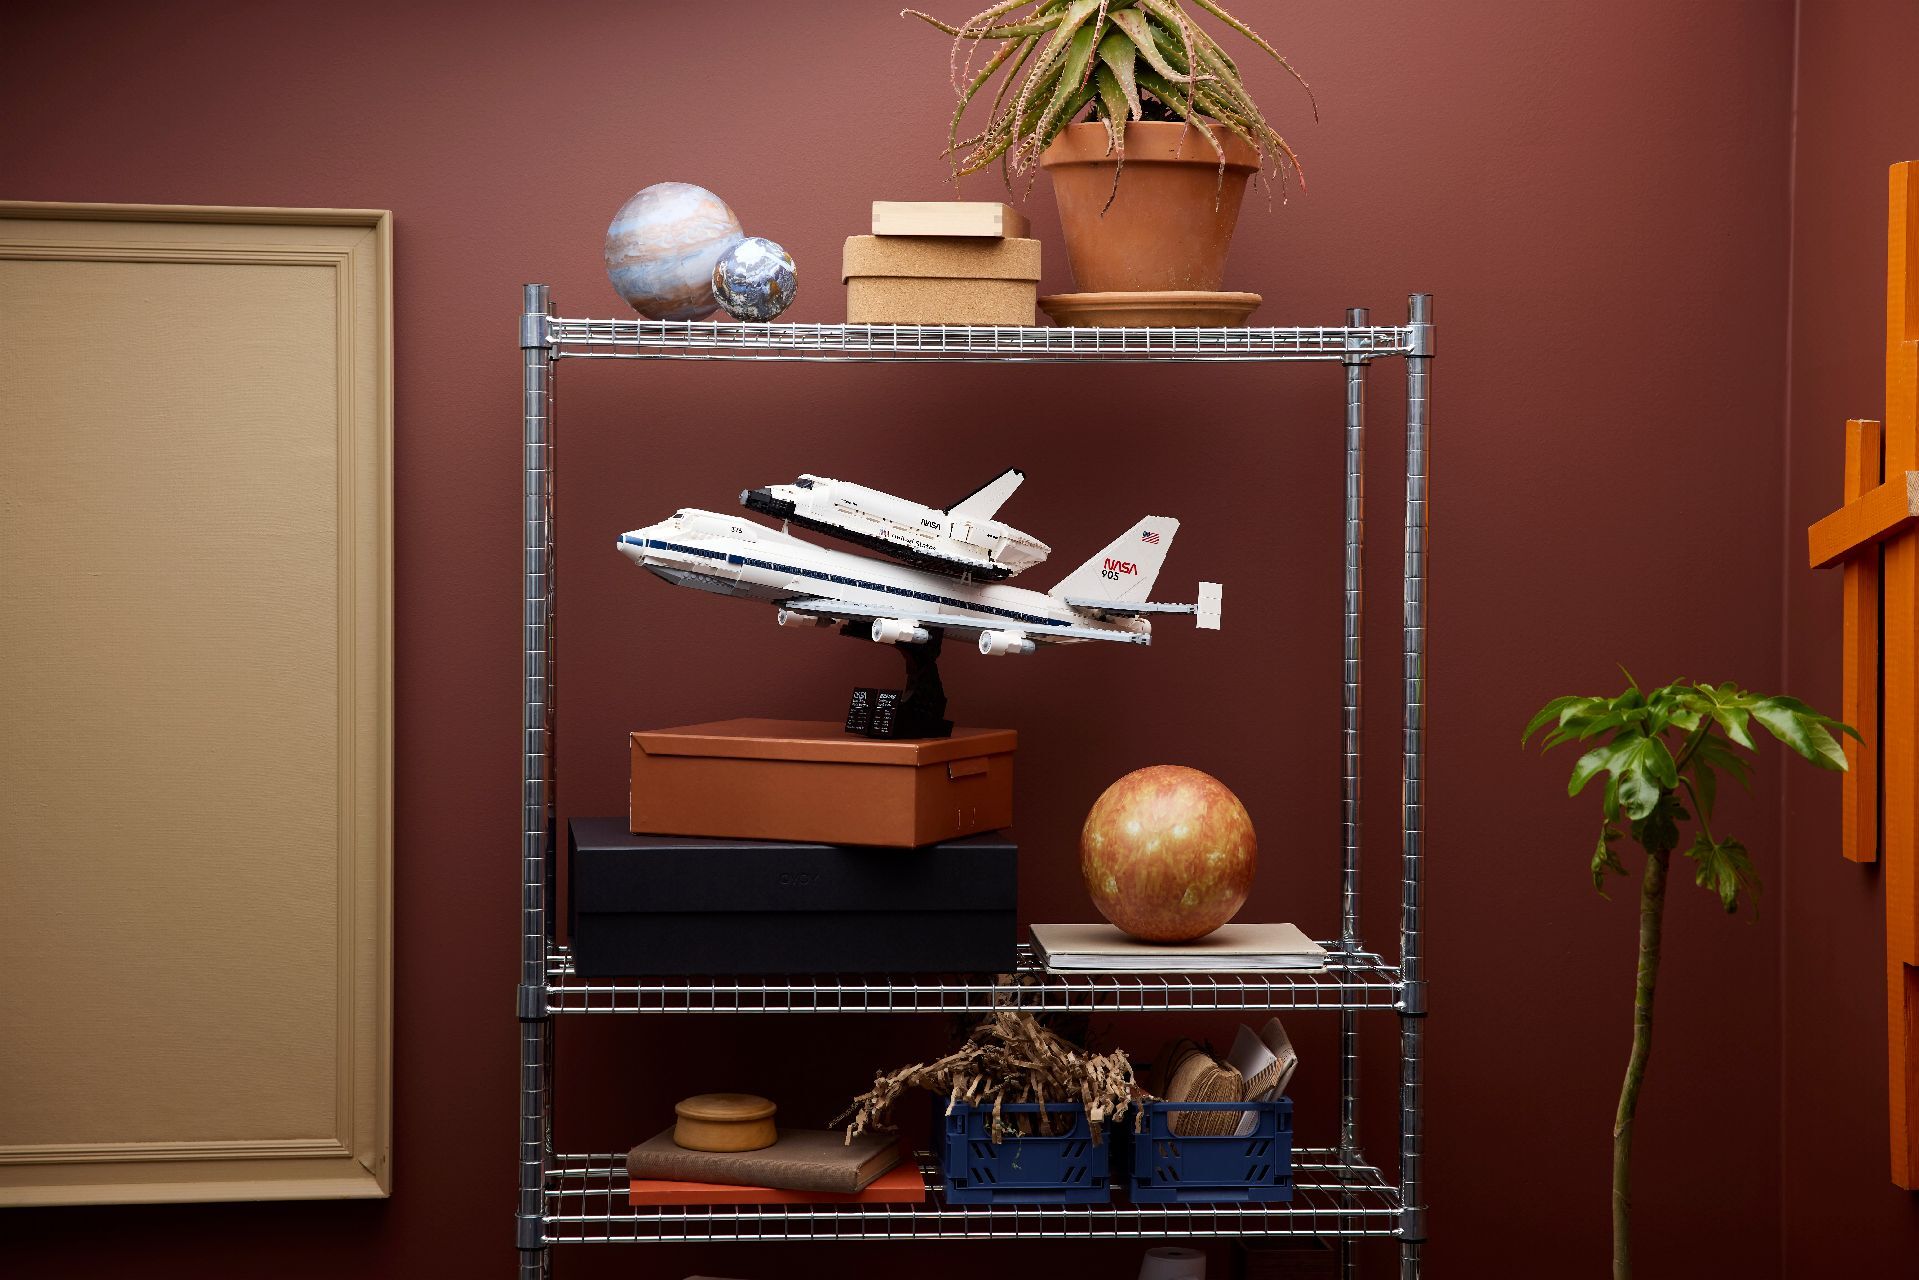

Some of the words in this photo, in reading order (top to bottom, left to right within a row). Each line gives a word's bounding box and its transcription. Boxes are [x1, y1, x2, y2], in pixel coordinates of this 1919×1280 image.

[920, 518, 941, 530] NASA
[1104, 558, 1137, 575] NASA
[1101, 569, 1120, 580] 905
